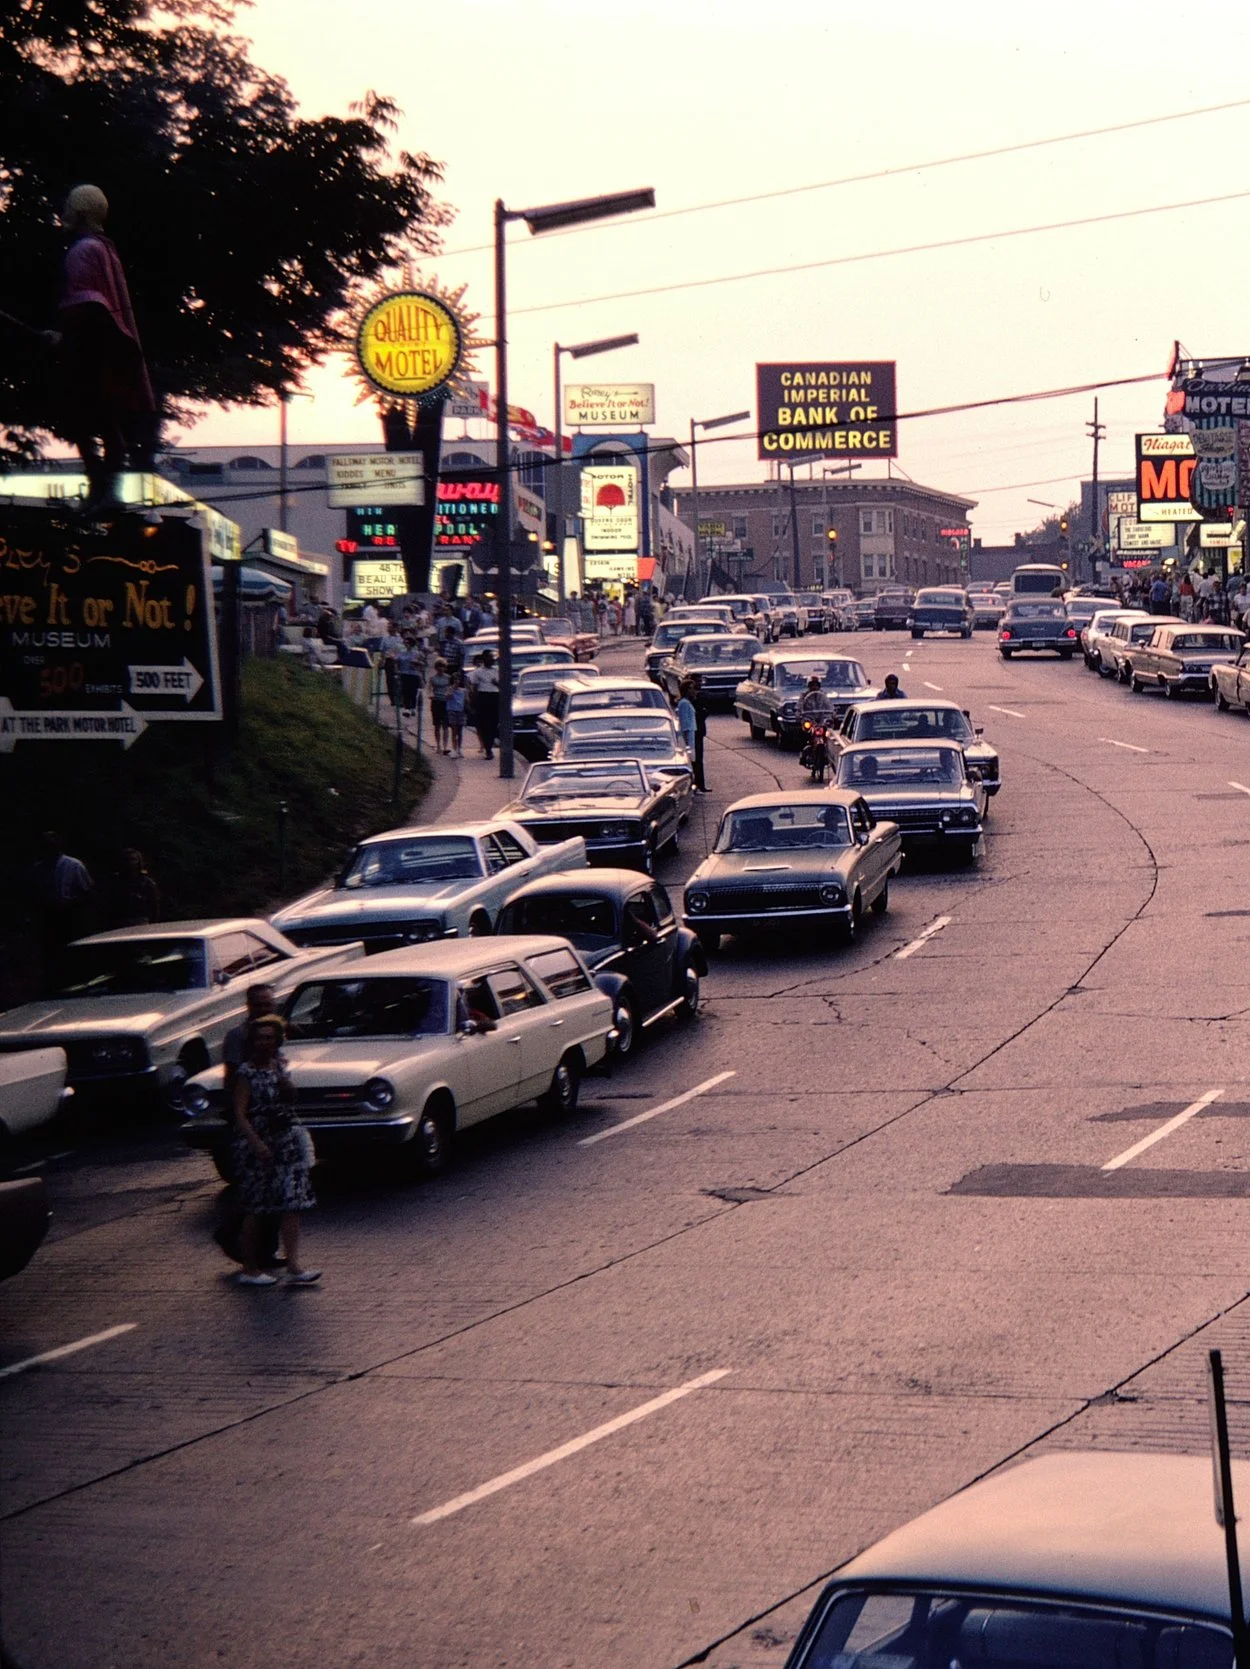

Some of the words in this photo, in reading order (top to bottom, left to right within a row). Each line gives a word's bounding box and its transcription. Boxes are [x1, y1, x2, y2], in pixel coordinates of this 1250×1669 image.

[374, 304, 442, 342] QUALITY
[375, 349, 443, 377] MOTEL
[780, 371, 872, 387] CANADIAN
[783, 388, 870, 403] IMPERIAL
[569, 399, 605, 409] Believe
[607, 399, 616, 408] It
[628, 397, 649, 408] Not!
[578, 410, 639, 421] MUSEUM
[777, 407, 838, 425] BANK
[850, 405, 878, 422] OF
[763, 430, 892, 450] COMMERCE
[1143, 436, 1191, 453] Niagar
[1109, 493, 1133, 502] CLIF
[438, 503, 498, 515] ITIONED
[1109, 503, 1136, 513] MOT
[1161, 508, 1193, 516] HEATED
[363, 525, 398, 536] HEA
[358, 575, 387, 584] BEAU
[366, 586, 393, 595] SHOW
[46, 582, 72, 626] It
[83, 596, 115, 628] or
[12, 631, 113, 648] MUSEUM
[24, 655, 46, 665] OVER
[136, 672, 160, 687] 500
[164, 672, 193, 688] FEET
[85, 683, 124, 694] EXHIBITS
[1, 718, 17, 733] AT
[20, 718, 40, 733] THE
[43, 718, 70, 733] PARK
[73, 718, 106, 733] MOTOR
[107, 717, 137, 733] HOTEL
